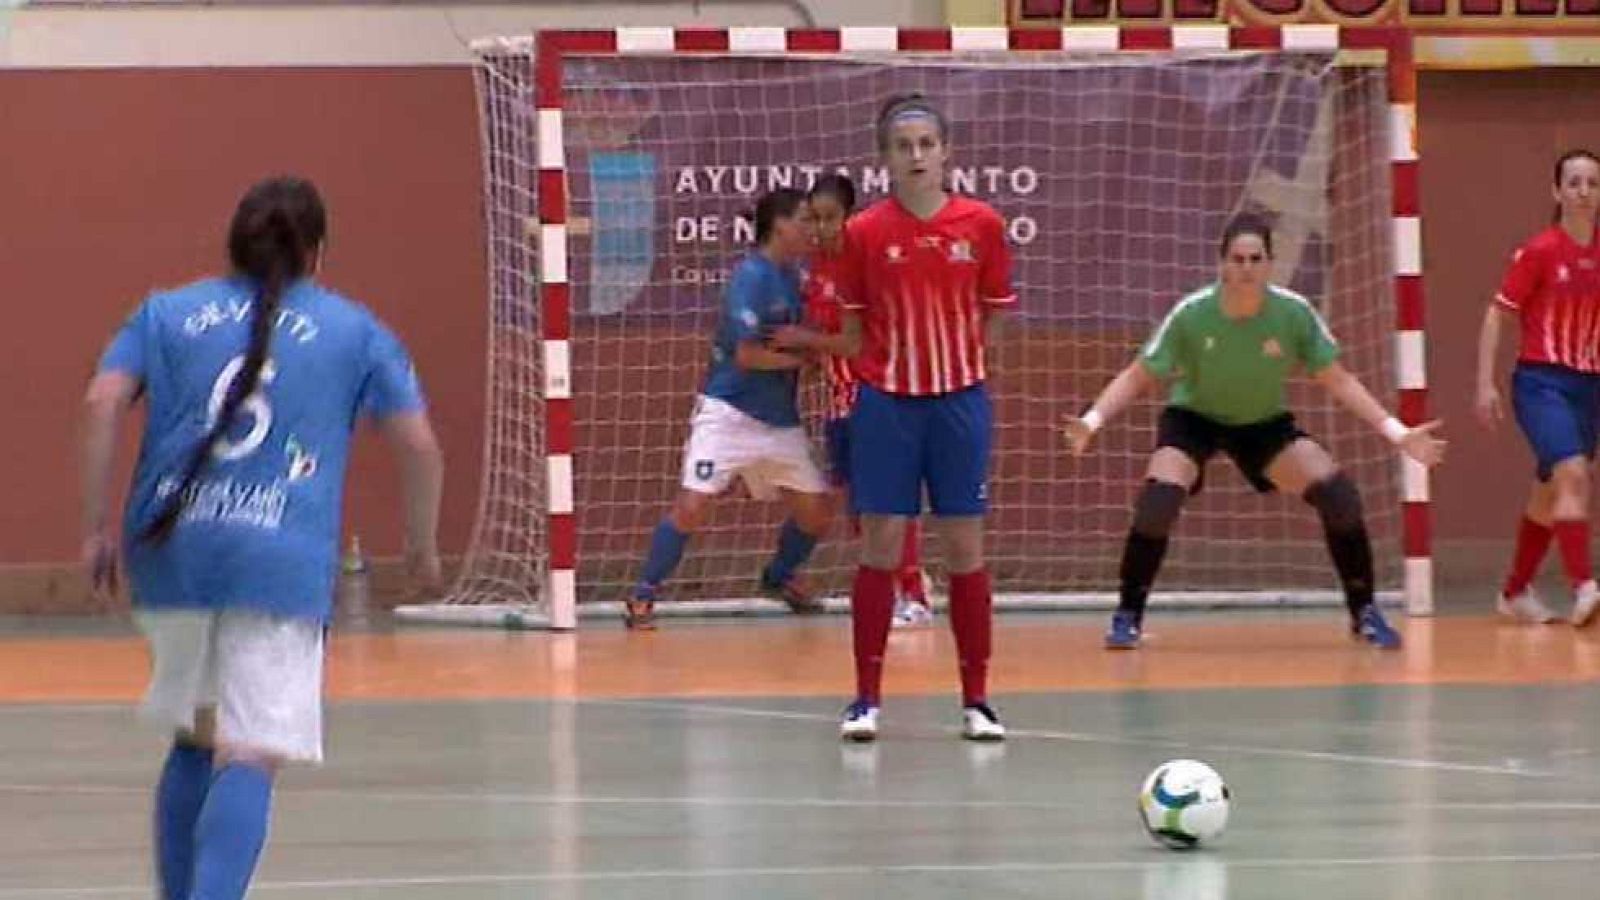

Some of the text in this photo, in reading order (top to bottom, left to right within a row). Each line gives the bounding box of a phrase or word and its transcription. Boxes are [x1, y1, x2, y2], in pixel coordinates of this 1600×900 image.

[675, 164, 1038, 194] AYUNTMNTO
[675, 215, 720, 242] DE
[207, 353, 276, 461] 6
